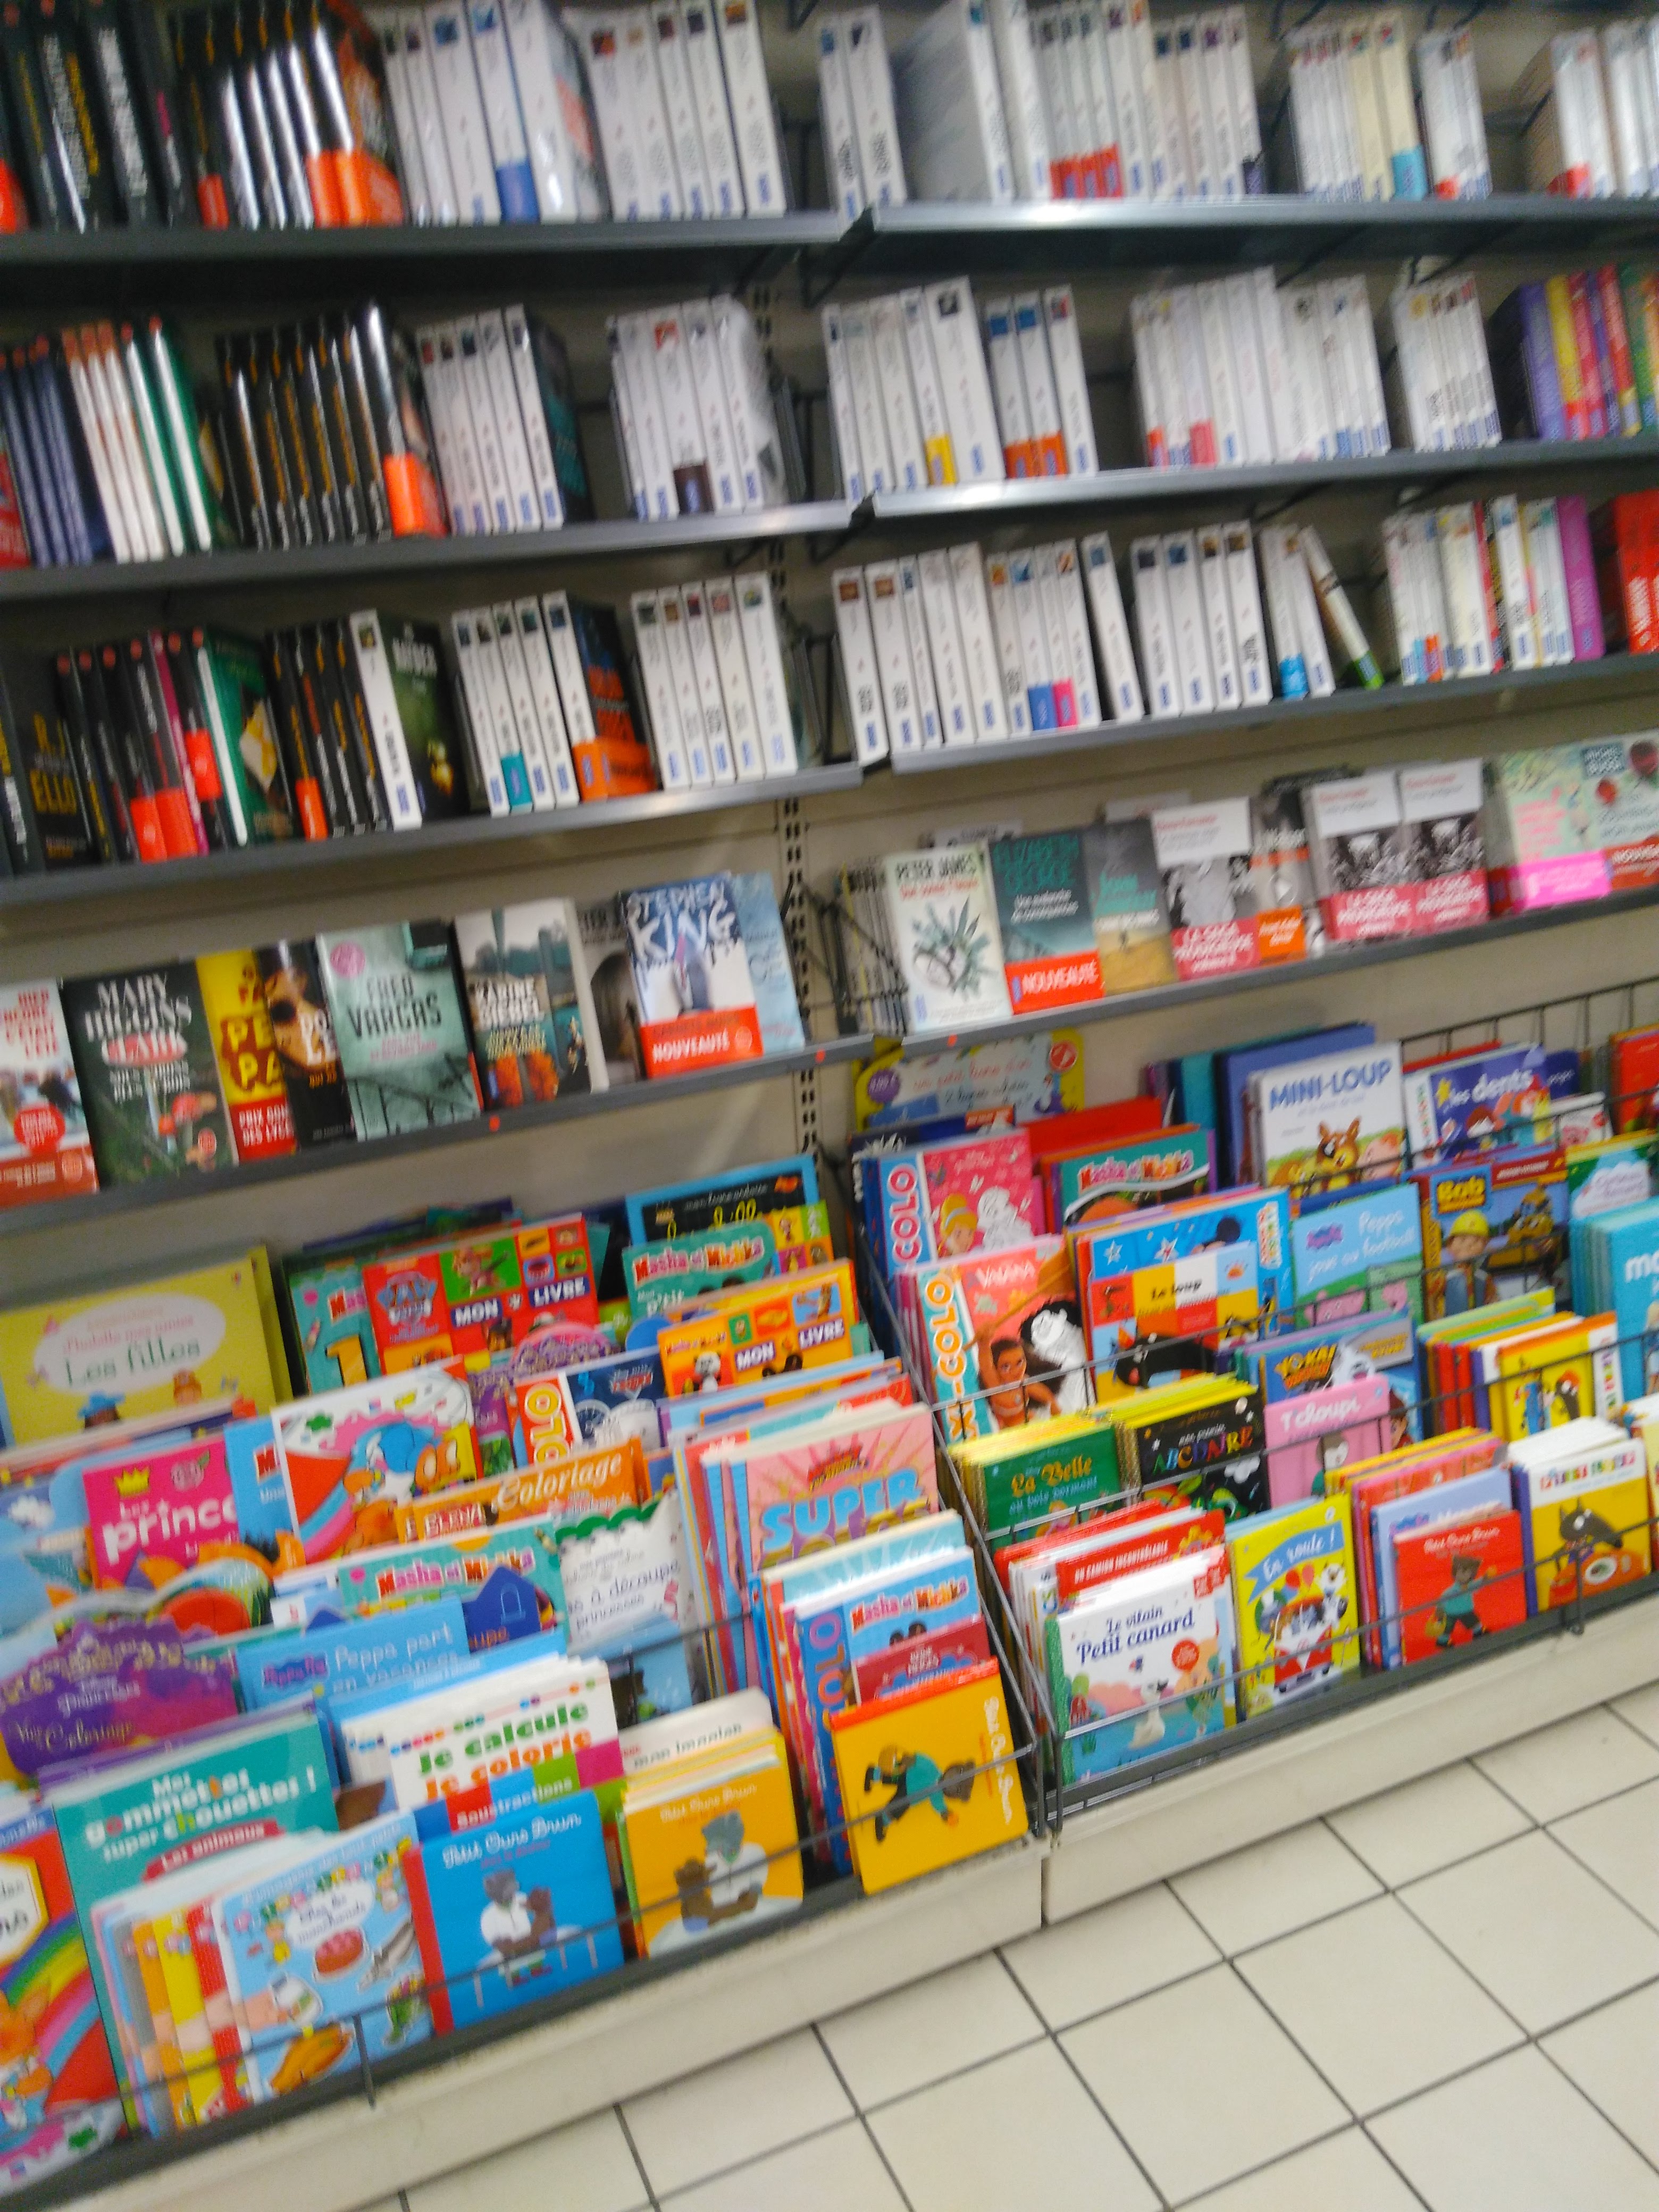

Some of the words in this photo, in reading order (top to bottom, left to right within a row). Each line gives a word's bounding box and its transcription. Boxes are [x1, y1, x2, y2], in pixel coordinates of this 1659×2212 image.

[895, 858, 933, 882] PETER
[939, 853, 977, 877] JAMES
[627, 881, 725, 921] STEPHEN
[628, 899, 736, 960] KING
[97, 973, 168, 1006] MARY
[366, 974, 414, 1001] FRED
[85, 998, 192, 1041] HIGGINS
[347, 991, 442, 1039] VARGAS
[102, 1032, 188, 1064] CLARK
[652, 1029, 730, 1063] NOUVEAUTÉ
[1269, 1059, 1392, 1112] MINI-LOUP
[1471, 1068, 1534, 1104] dents
[1437, 1174, 1486, 1204] Bob
[633, 1247, 688, 1288] Masha
[454, 1300, 499, 1328] MON
[532, 1277, 587, 1308] LIVRE
[65, 1356, 116, 1387] Les
[127, 1335, 200, 1377] filles
[735, 1341, 776, 1372] MON
[799, 1318, 845, 1349] LIVRE
[495, 1452, 622, 1513] Coloriage
[1011, 1473, 1036, 1498] La
[1041, 1455, 1093, 1488] Belle
[425, 1502, 485, 1539] ELENA
[762, 1466, 924, 1552] SUPER
[376, 1557, 445, 1598] Masha
[1262, 1553, 1285, 1581] En
[1286, 1532, 1326, 1564] route
[1329, 1528, 1336, 1549] !
[850, 1593, 901, 1635] Masha
[915, 1576, 969, 1612] Michka
[335, 1641, 398, 1673] Peppa
[406, 1621, 454, 1662] part
[1076, 1633, 1123, 1666] Petit
[1126, 1607, 1195, 1647] canard
[464, 1703, 589, 1759] calcule
[470, 1728, 592, 1787] colorie
[85, 1767, 250, 1850] gommettes
[152, 1770, 190, 1799] Mes
[103, 1826, 158, 1863] super
[163, 1775, 299, 1841] chouettes
[306, 1765, 317, 1793] !
[192, 1823, 265, 1857] animaux
[441, 1841, 483, 1870] Petit
[485, 1828, 529, 1854] Ours
[531, 1813, 582, 1840] Brun
